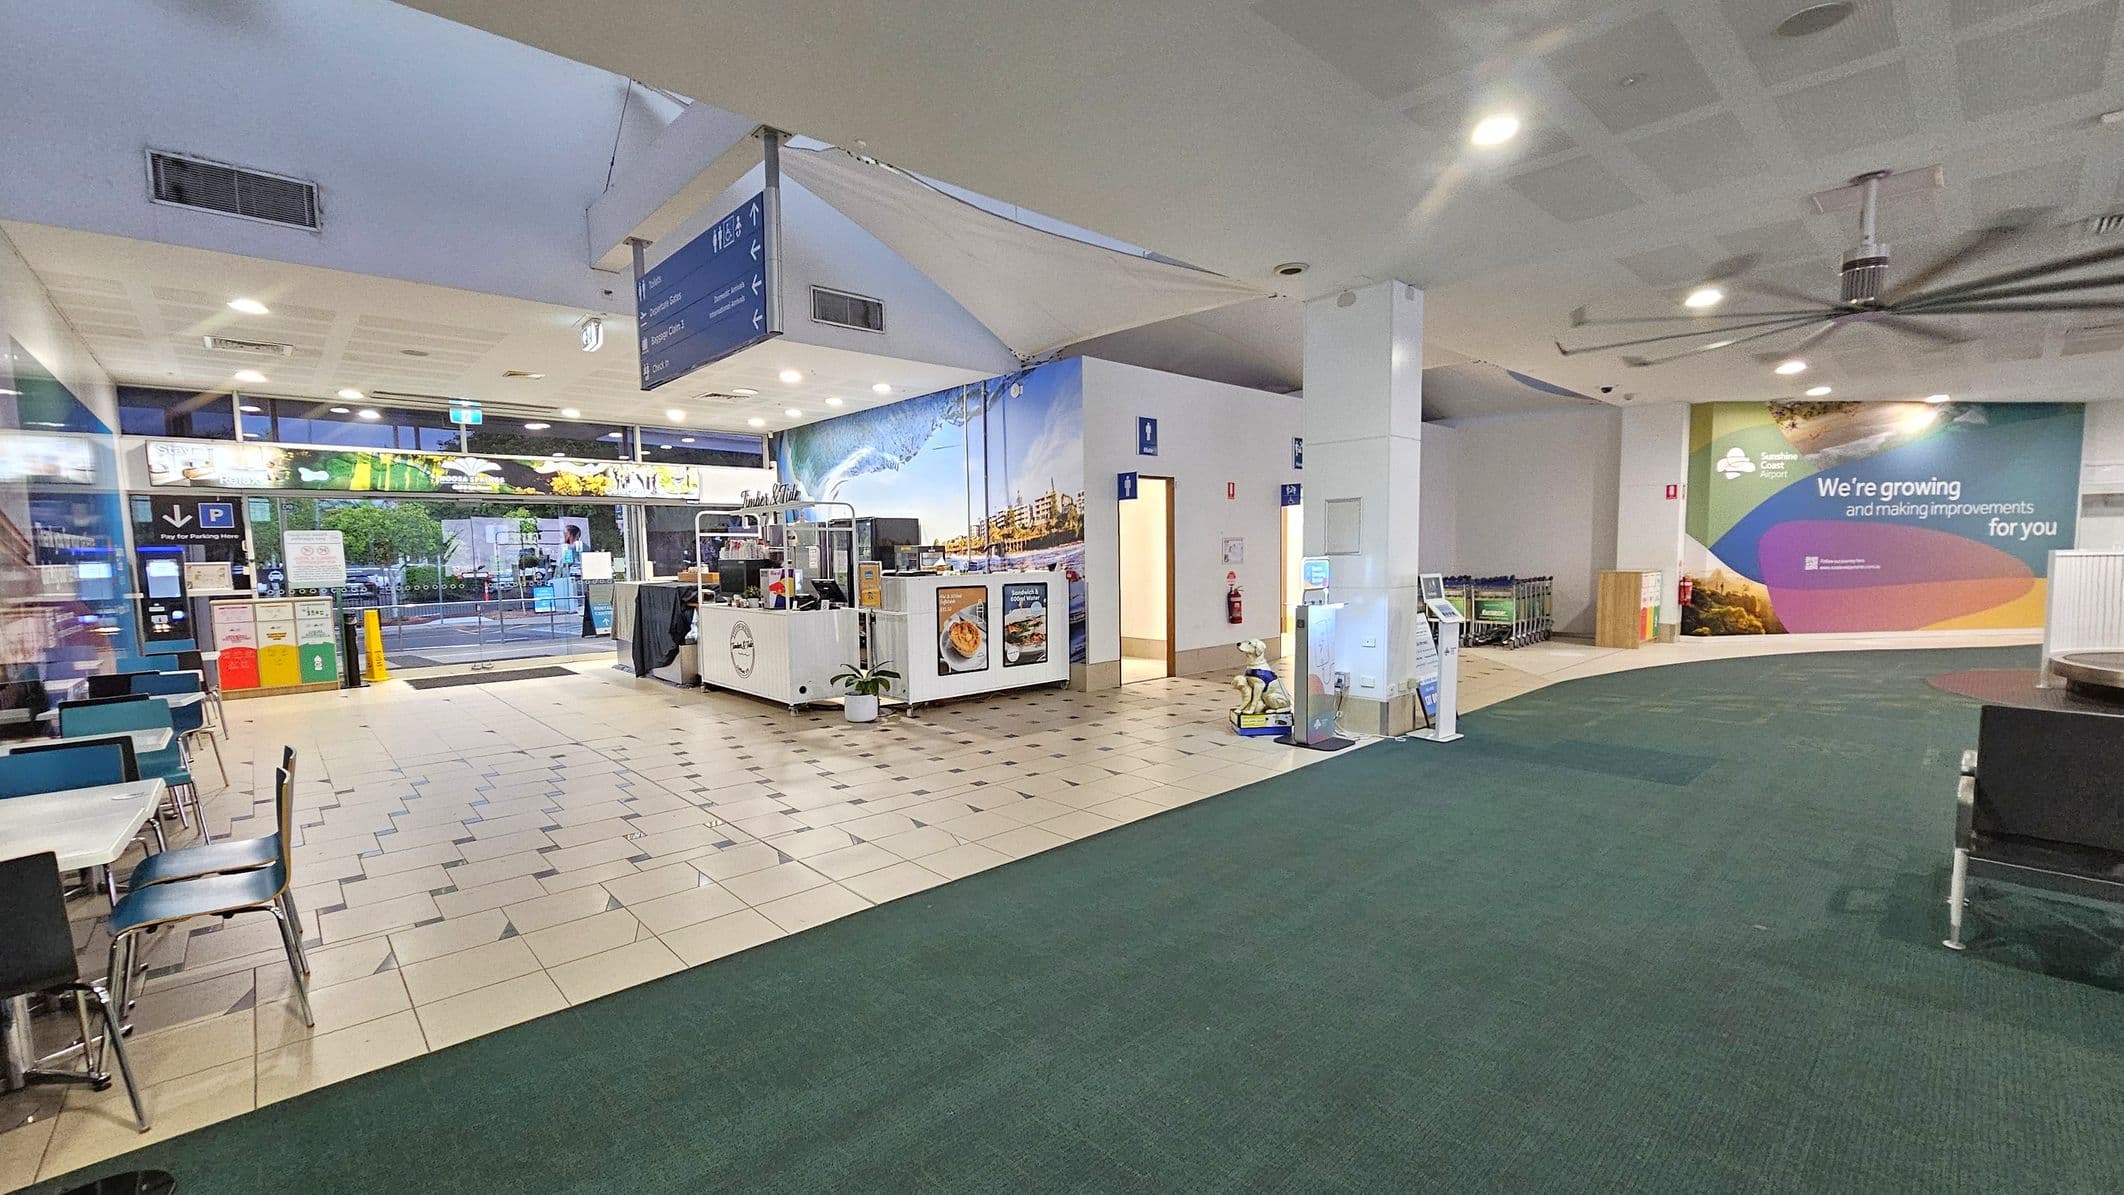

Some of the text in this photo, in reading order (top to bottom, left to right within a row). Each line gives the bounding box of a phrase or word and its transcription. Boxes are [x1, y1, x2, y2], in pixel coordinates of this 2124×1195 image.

[1760, 451, 1799, 460] Sunshine
[1760, 461, 1785, 470] Coast
[1760, 470, 1788, 480] Airport
[1817, 477, 1961, 501] We're growing
[740, 489, 768, 508] Timber
[209, 508, 224, 522] P
[1846, 501, 2035, 519] and making improvements
[1989, 518, 2058, 541] for you
[1012, 588, 1035, 596] Sandwich
